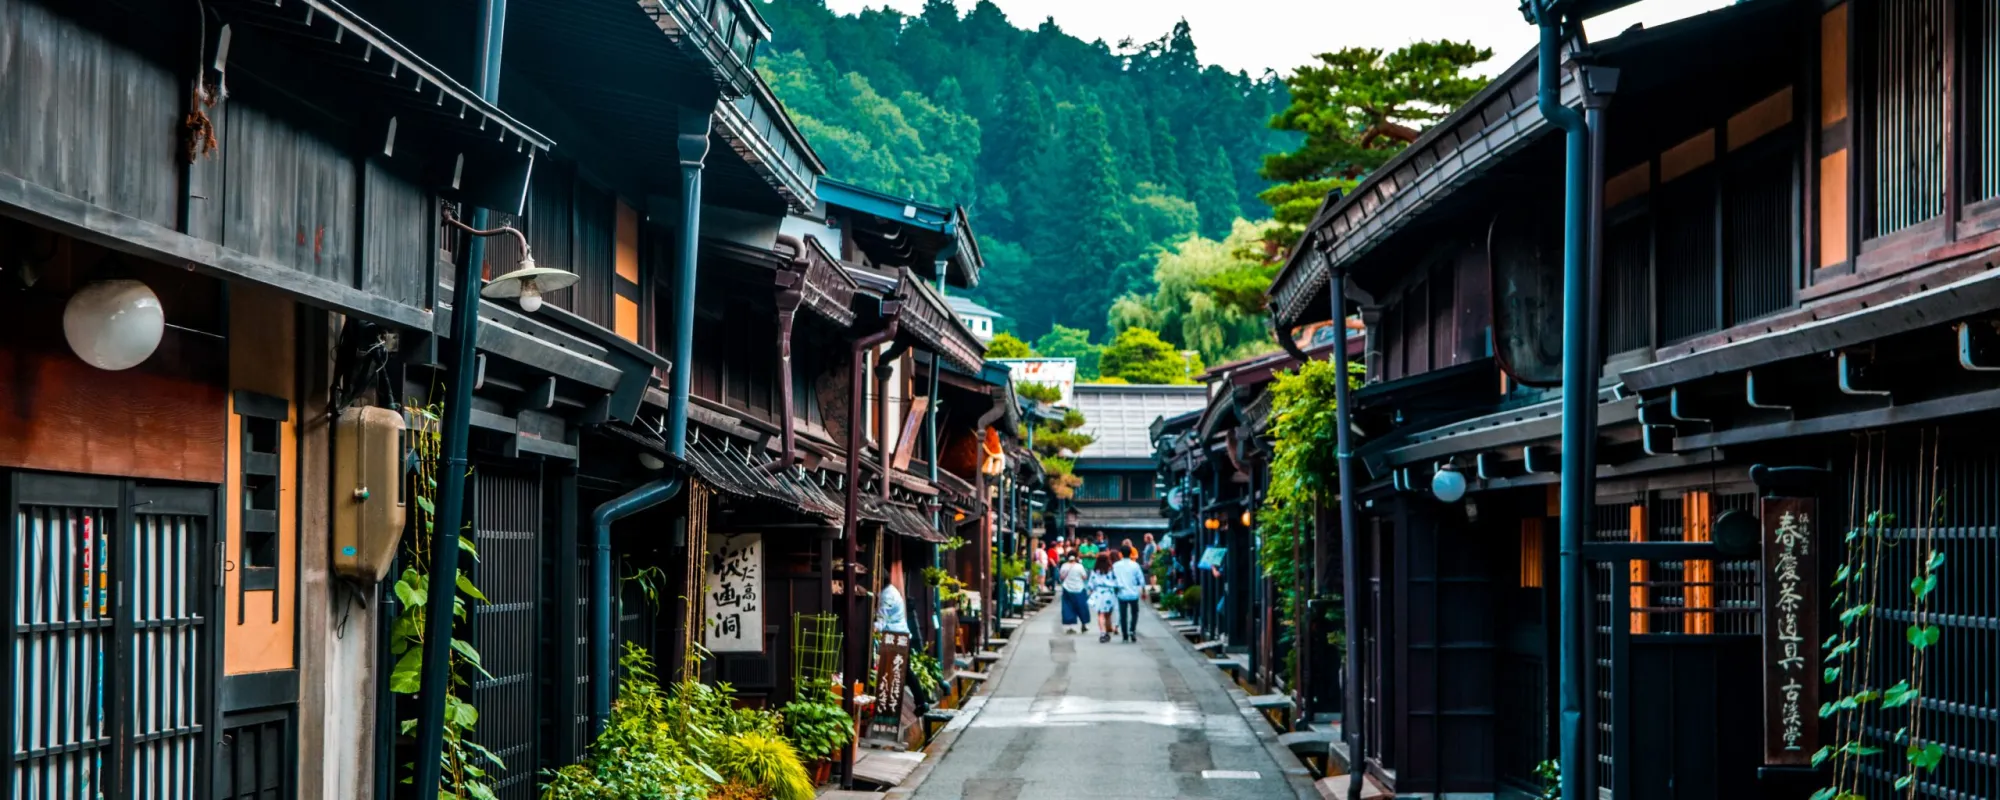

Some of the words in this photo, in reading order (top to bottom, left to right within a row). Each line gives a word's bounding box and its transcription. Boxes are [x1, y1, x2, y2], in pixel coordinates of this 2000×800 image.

[1774, 511, 1805, 671] 春慶茶道具
